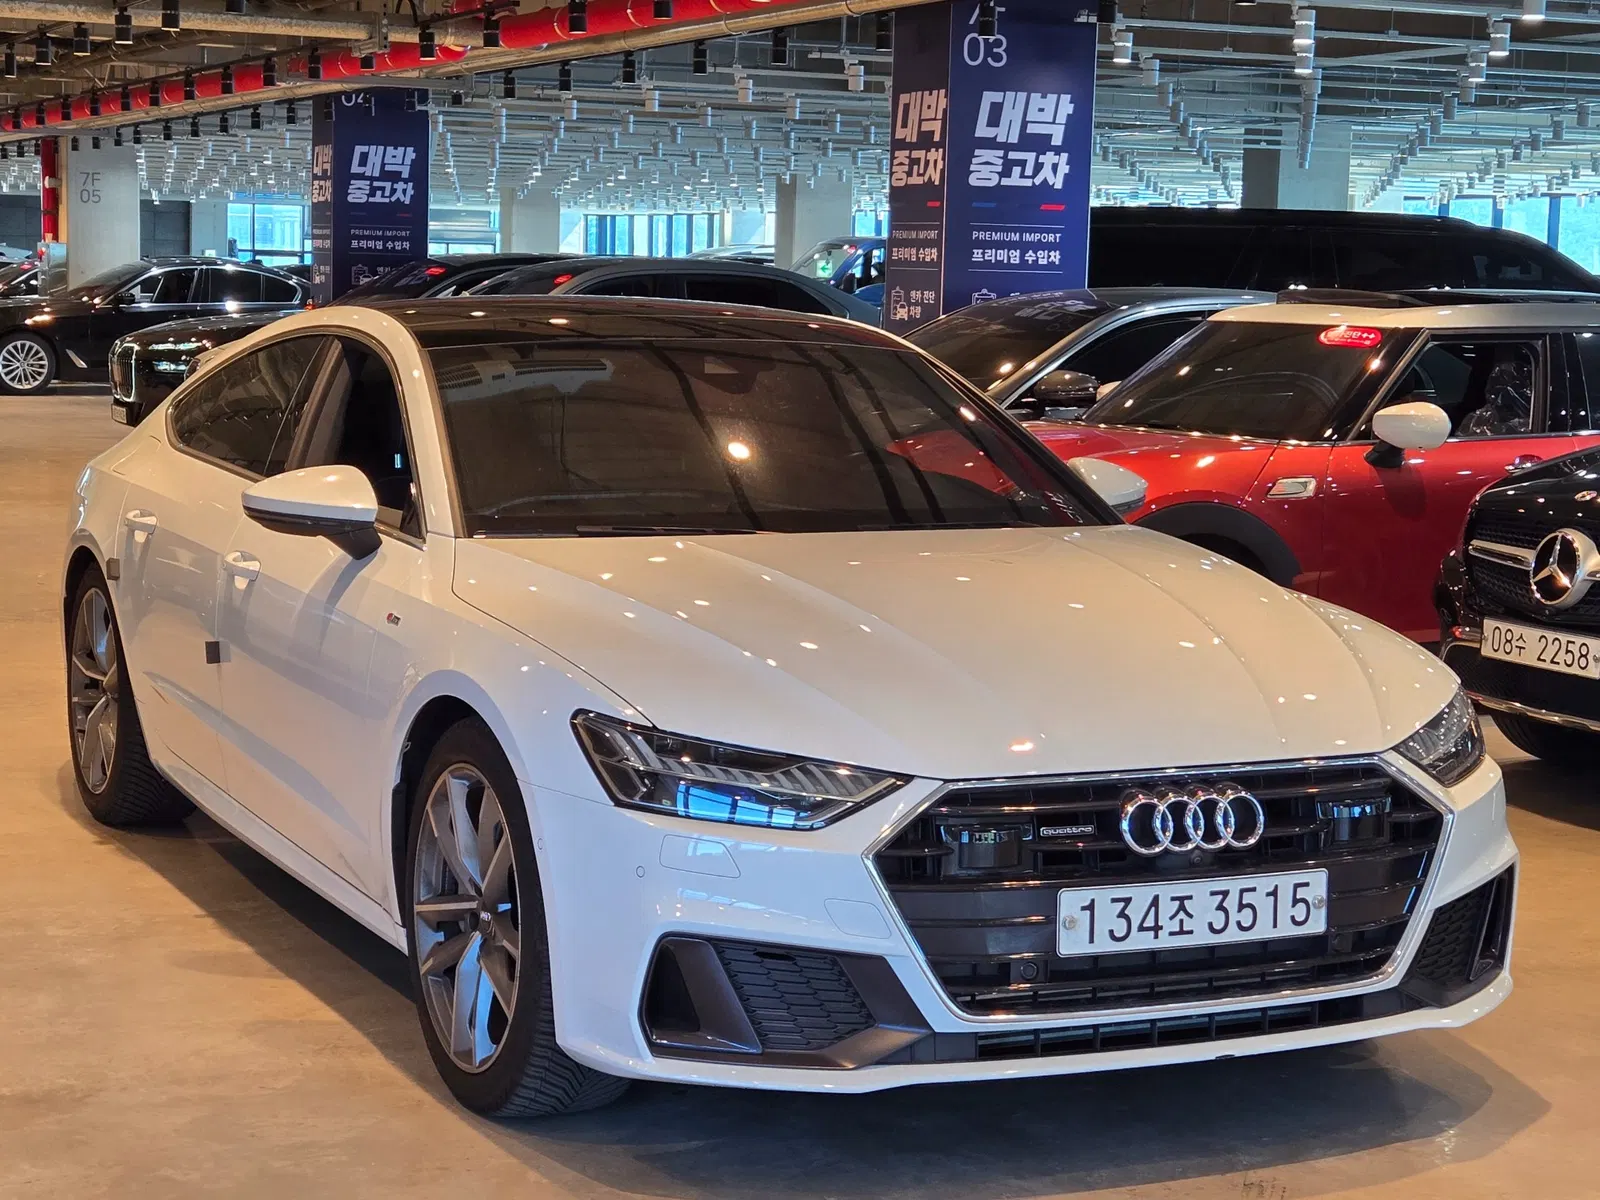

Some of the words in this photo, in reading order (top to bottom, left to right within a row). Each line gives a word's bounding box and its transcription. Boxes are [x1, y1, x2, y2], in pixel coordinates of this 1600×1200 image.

[963, 32, 1007, 67] 03
[895, 88, 947, 143] 대박
[974, 91, 1075, 146] 대박
[313, 144, 332, 176] 대박
[350, 145, 416, 178] 대박
[891, 147, 944, 188] 중고차
[967, 149, 1070, 190] 중고차
[80, 172, 101, 186] 7F
[312, 179, 332, 203] 중고차
[80, 189, 101, 203] 05
[347, 179, 415, 205] 중고차
[350, 239, 383, 249] 프리미엄
[386, 240, 410, 250] 수입차
[351, 228, 382, 236] PREMIUM
[384, 229, 410, 237] IMPORT
[892, 230, 916, 239] PREMIUM
[917, 230, 939, 239] IMPORT
[972, 231, 1020, 242] PREMIUM
[1022, 232, 1061, 243] IMPORT
[891, 247, 917, 261] 프리미엄
[918, 247, 938, 262] 수입차
[971, 248, 1020, 264] 프리미엄
[1024, 250, 1061, 265] 수입차
[1491, 626, 1527, 657] 08수
[1537, 634, 1590, 671] 2258
[1043, 827, 1092, 835] quattro
[1080, 893, 1194, 944] 134조
[1207, 881, 1312, 935] 3515
